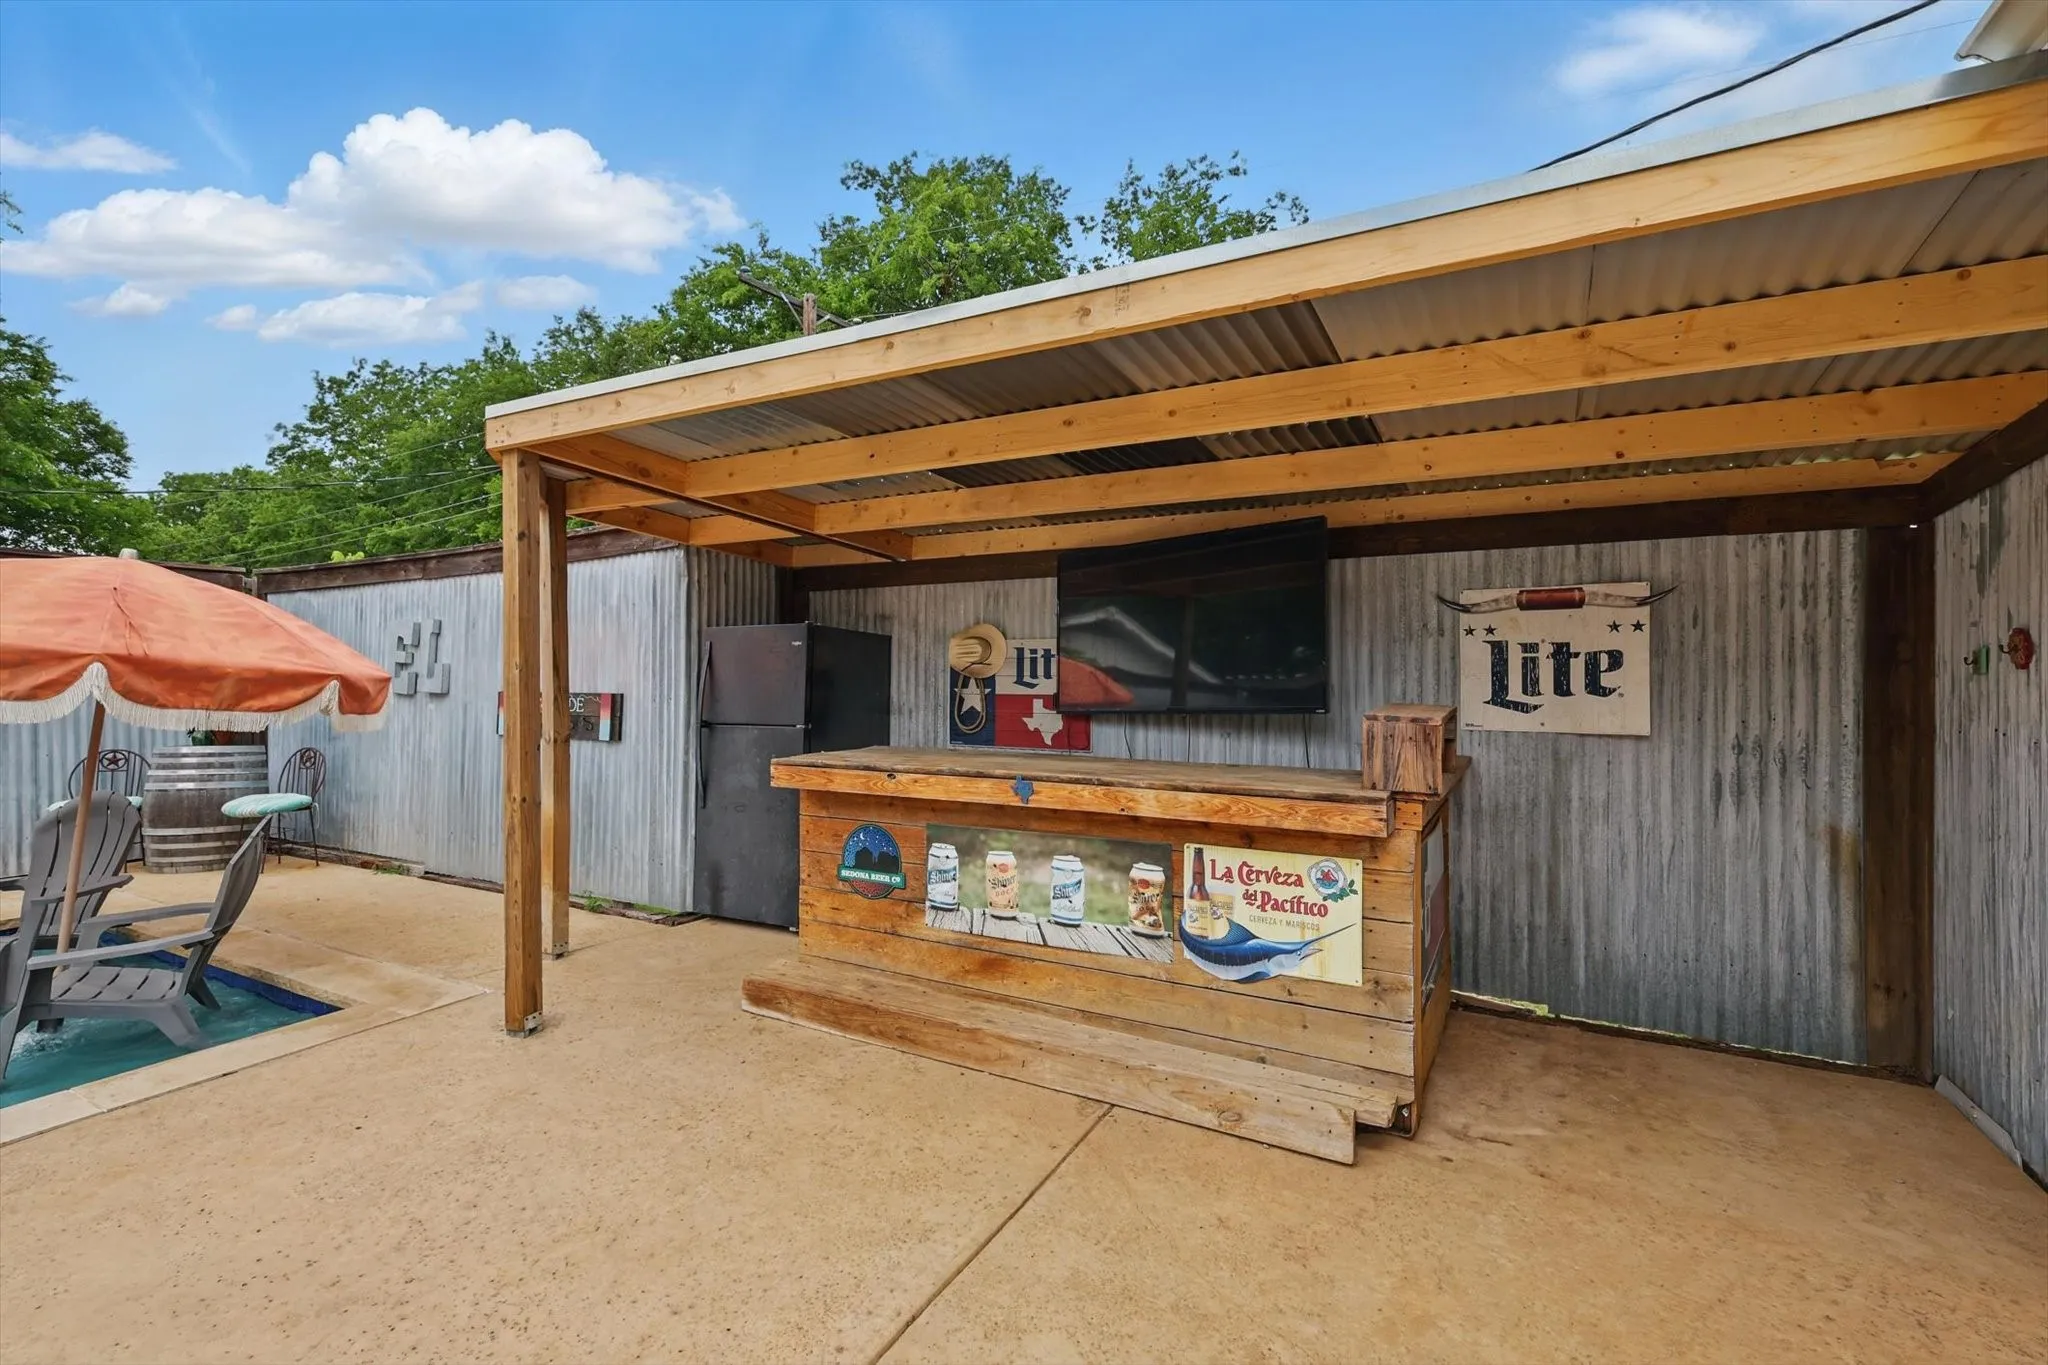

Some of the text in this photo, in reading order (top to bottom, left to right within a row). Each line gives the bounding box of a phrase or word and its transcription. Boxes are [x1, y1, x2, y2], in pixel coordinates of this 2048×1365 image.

[1012, 646, 1056, 690] Lit
[1481, 639, 1625, 715] Lite
[840, 869, 870, 881] SEDONA
[870, 873, 891, 883] BEER
[929, 870, 957, 885] Shine
[1209, 858, 1305, 888] La Cerveza
[1242, 888, 1258, 907] del
[1256, 891, 1329, 918] Pacífico
[1249, 915, 1277, 926] CERVEZA
